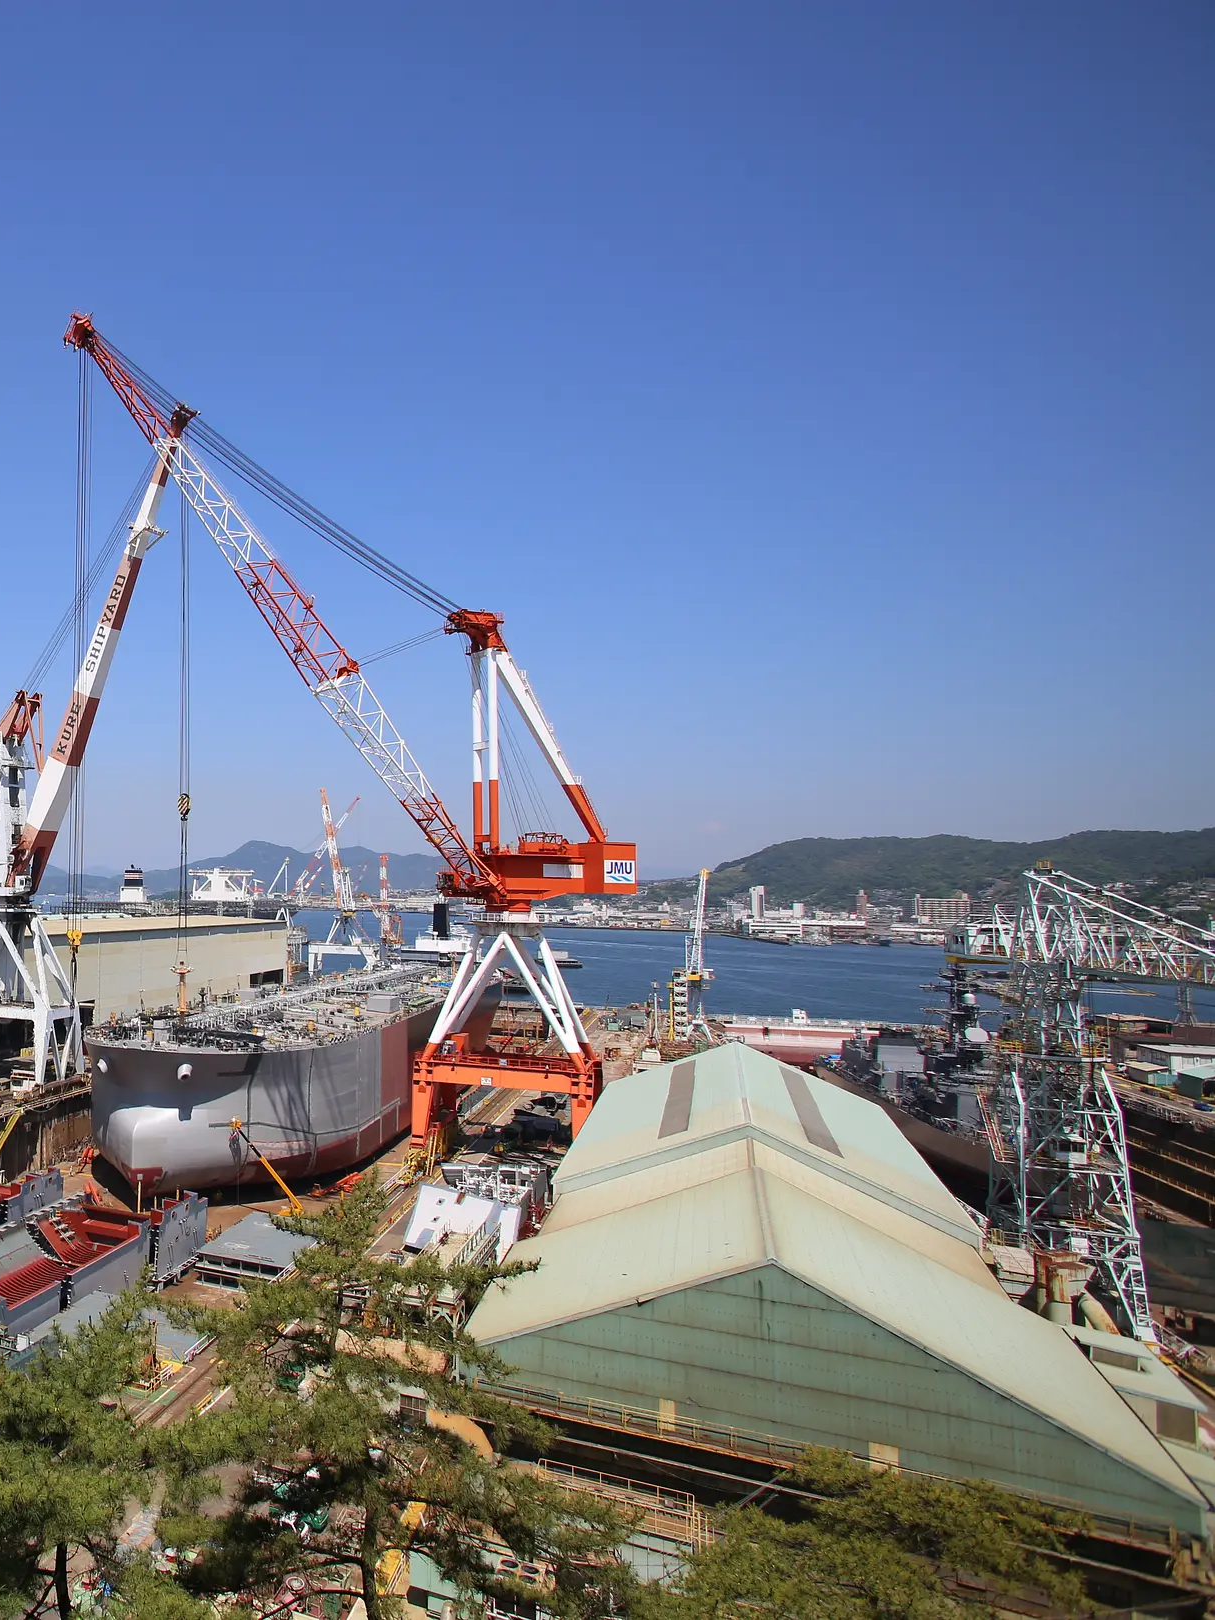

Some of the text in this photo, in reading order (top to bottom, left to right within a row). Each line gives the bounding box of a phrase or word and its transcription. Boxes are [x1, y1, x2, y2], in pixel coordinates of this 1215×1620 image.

[57, 574, 127, 755] KURE SHIPYARD
[606, 861, 633, 875] JMU
